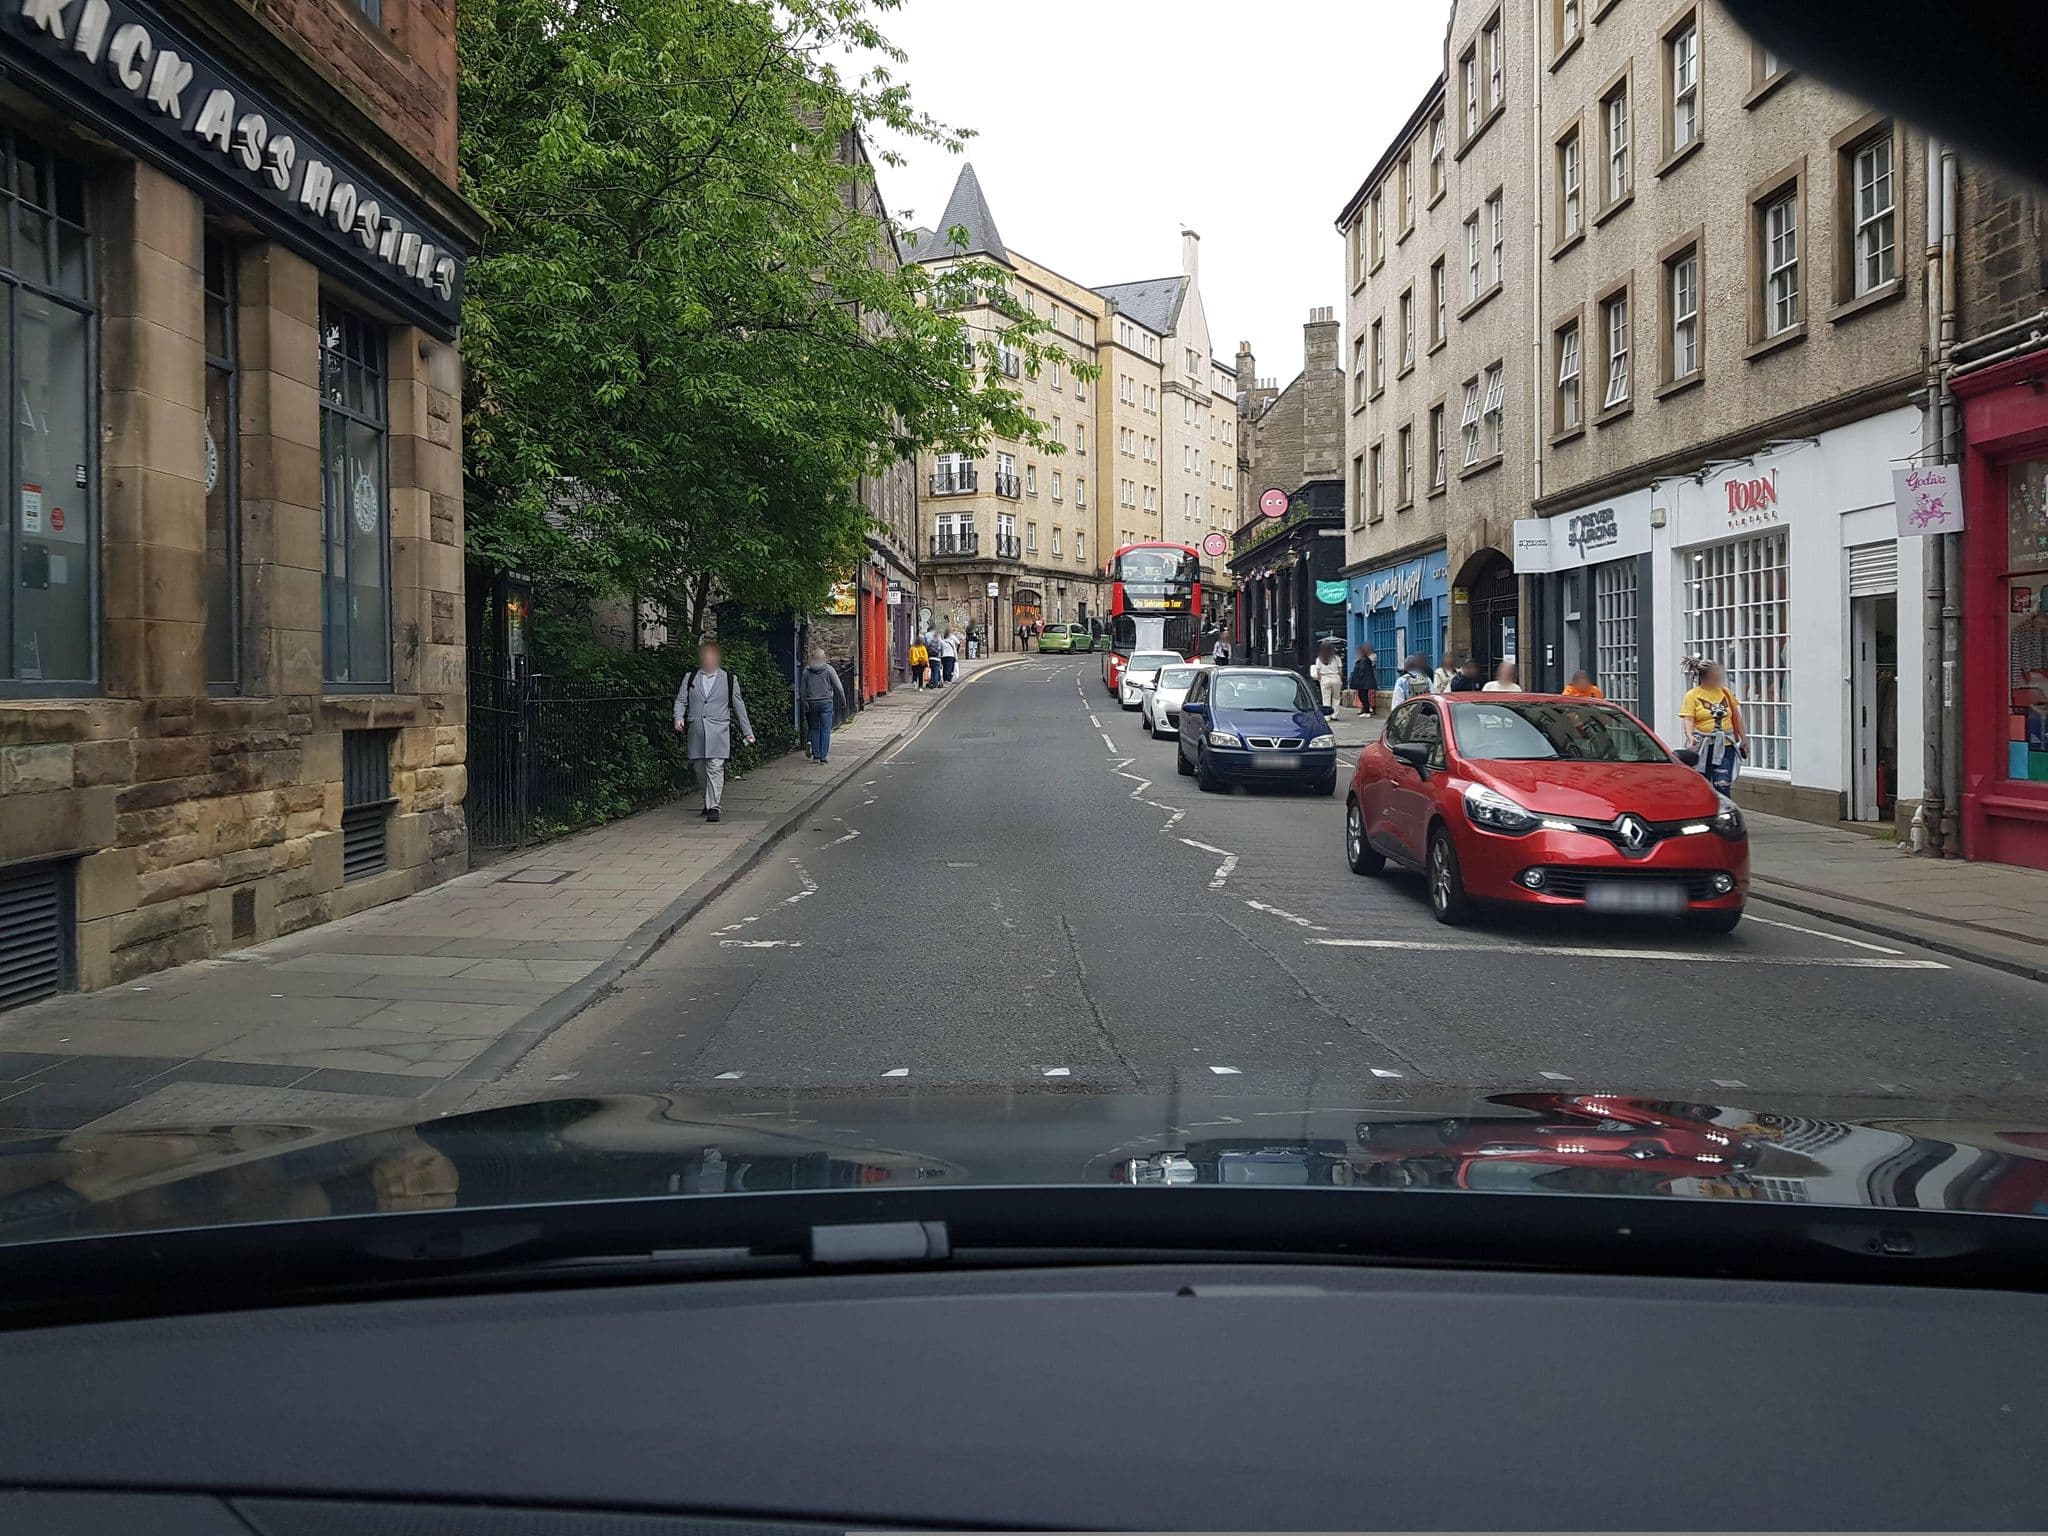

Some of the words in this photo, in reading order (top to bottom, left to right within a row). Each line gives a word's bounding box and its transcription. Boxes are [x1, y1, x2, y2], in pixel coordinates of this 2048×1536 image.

[20, 0, 194, 119] KICK
[194, 88, 296, 191] ASS
[300, 159, 457, 301] HOSTELS
[1724, 467, 1777, 514] TORN
[1905, 470, 1947, 491] Godiva
[1568, 507, 1615, 532] FOREVER
[1727, 510, 1778, 529] VINTAGE
[1568, 522, 1618, 547] SOURCING
